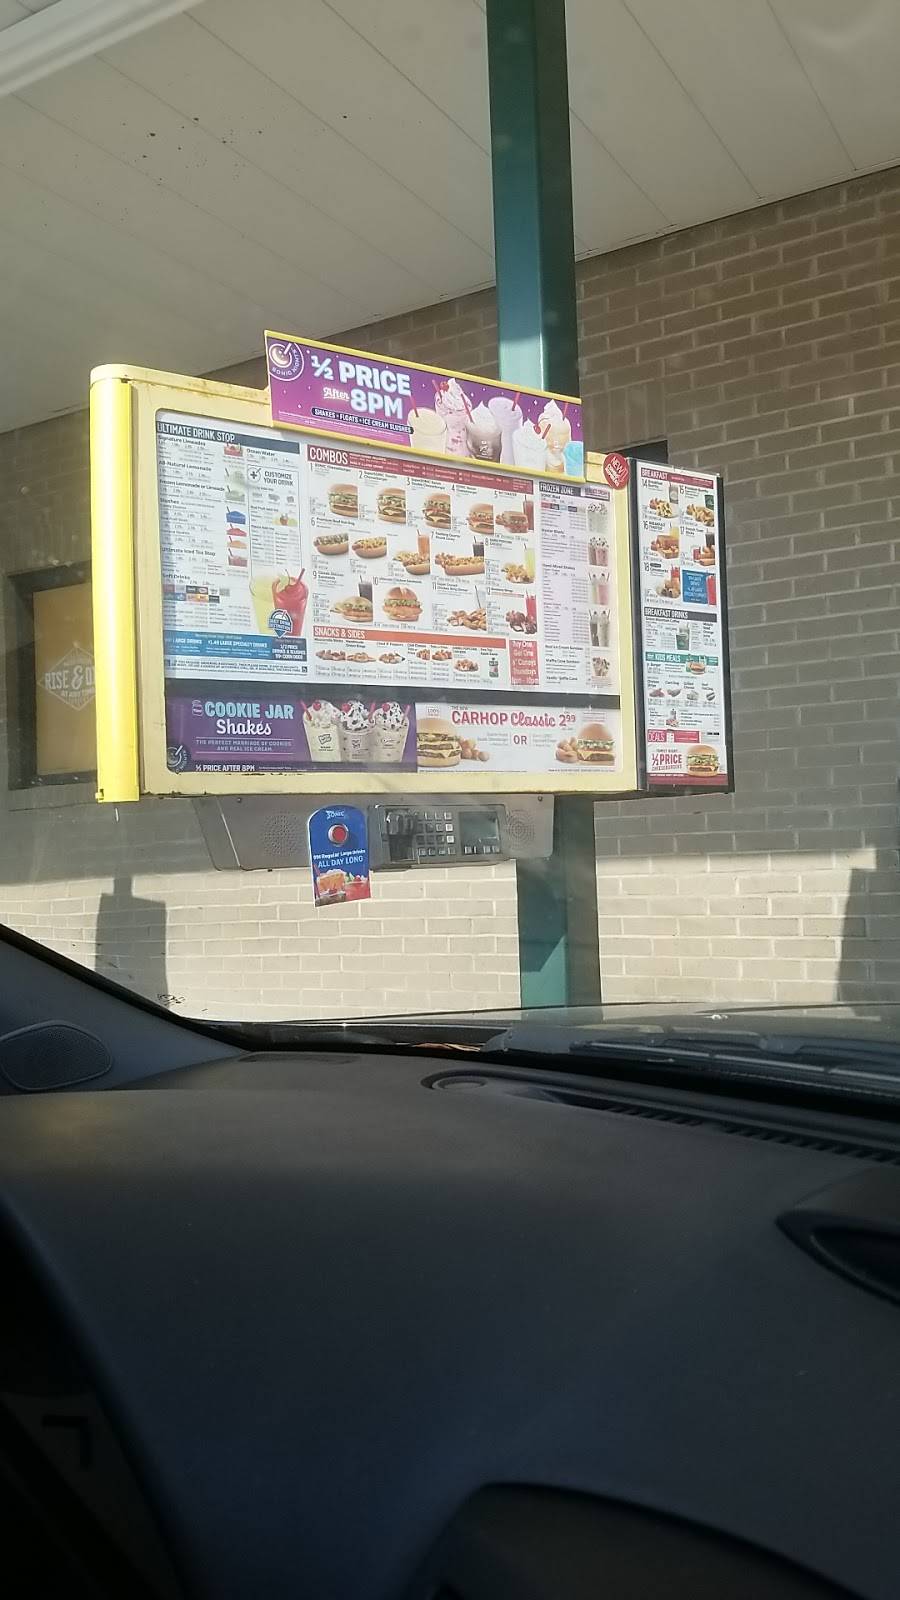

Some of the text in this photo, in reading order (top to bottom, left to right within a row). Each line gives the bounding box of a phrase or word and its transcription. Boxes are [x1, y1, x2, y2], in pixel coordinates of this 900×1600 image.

[338, 360, 412, 396] PRICE
[323, 387, 403, 419] After 8PM
[314, 408, 412, 433] SHAKES FLOATS ICE CREAM SLUSHES
[157, 423, 235, 443] ULTIMATE DRINK STOP
[309, 447, 349, 465] COMBOS
[264, 471, 293, 480] CUSTOMIZE
[358, 470, 363, 479] 2
[641, 468, 668, 480] BREAKFAST
[263, 477, 278, 485] YOUR
[406, 477, 411, 486] 3
[494, 490, 498, 498] 5
[540, 483, 560, 493] FROZEN
[560, 486, 574, 495] ZONE
[311, 518, 316, 526] 6
[312, 570, 317, 579] 9
[372, 576, 379, 586] 10
[644, 608, 689, 619] BREAKFAST DRINKS
[313, 626, 366, 639] SNACKS & SIDES
[655, 653, 681, 663] KIDS MEALS
[45, 670, 70, 690] RISE
[71, 665, 84, 690] &
[204, 701, 294, 720] COOKIE JAR
[451, 710, 509, 725] CARHOP
[510, 711, 556, 728] Classic
[216, 718, 273, 736] Shakes
[513, 735, 528, 745] OR
[647, 731, 666, 742] DEALS
[659, 753, 683, 766] PRICE
[203, 764, 222, 772] PRICE
[222, 764, 240, 772] AFTER
[318, 855, 364, 868] ALL DAY LONG
